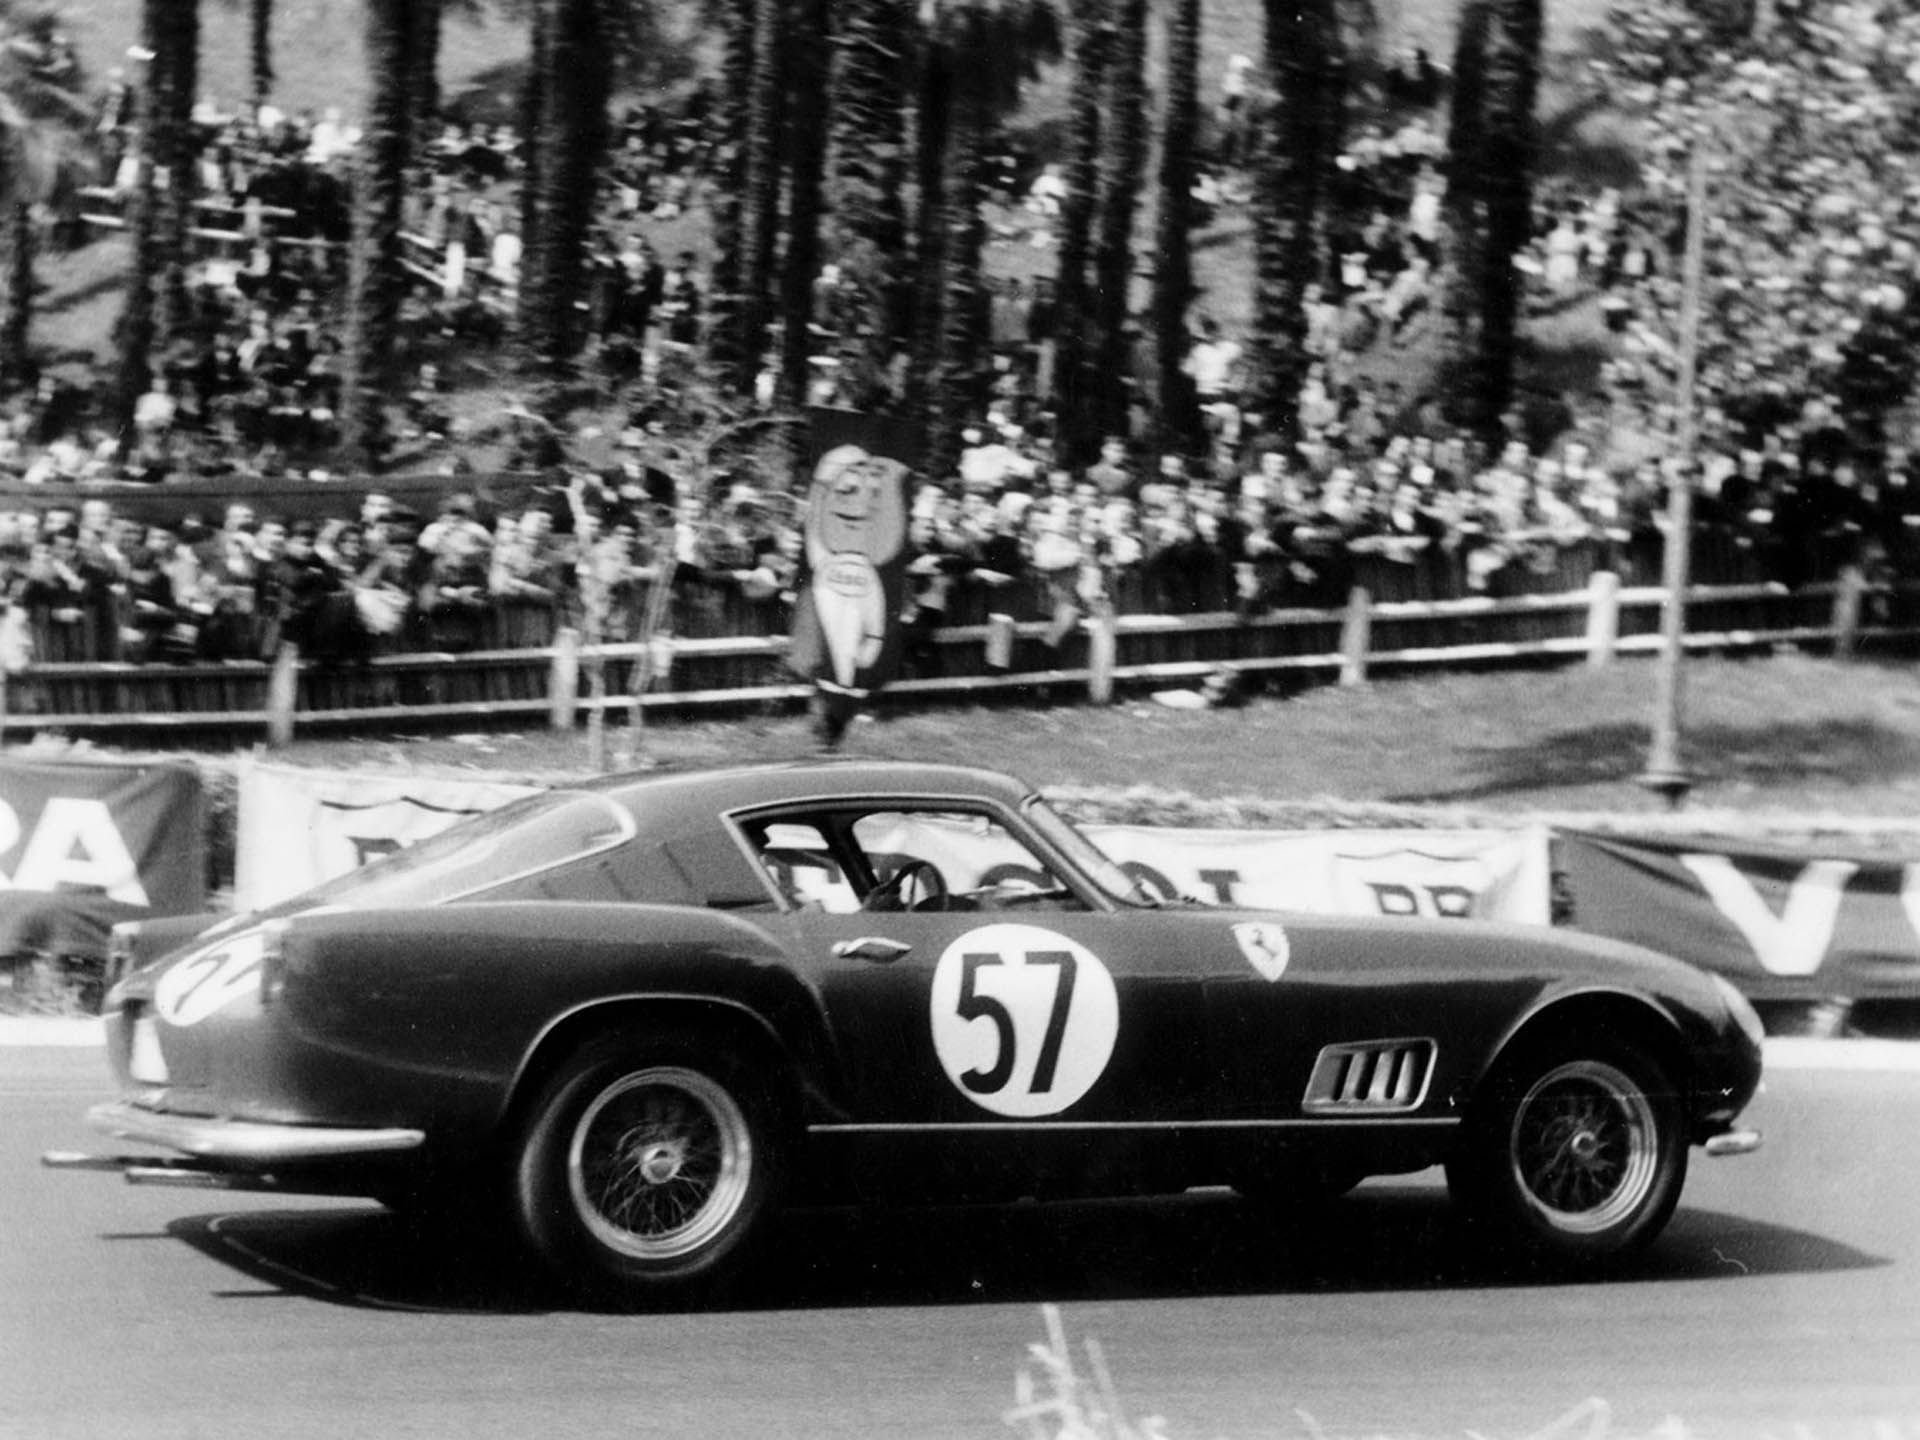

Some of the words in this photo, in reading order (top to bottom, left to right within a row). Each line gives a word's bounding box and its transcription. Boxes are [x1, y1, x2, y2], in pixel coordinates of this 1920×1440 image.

[0, 797, 150, 907] A
[1679, 853, 1920, 976] V
[956, 950, 1078, 1095] 57
